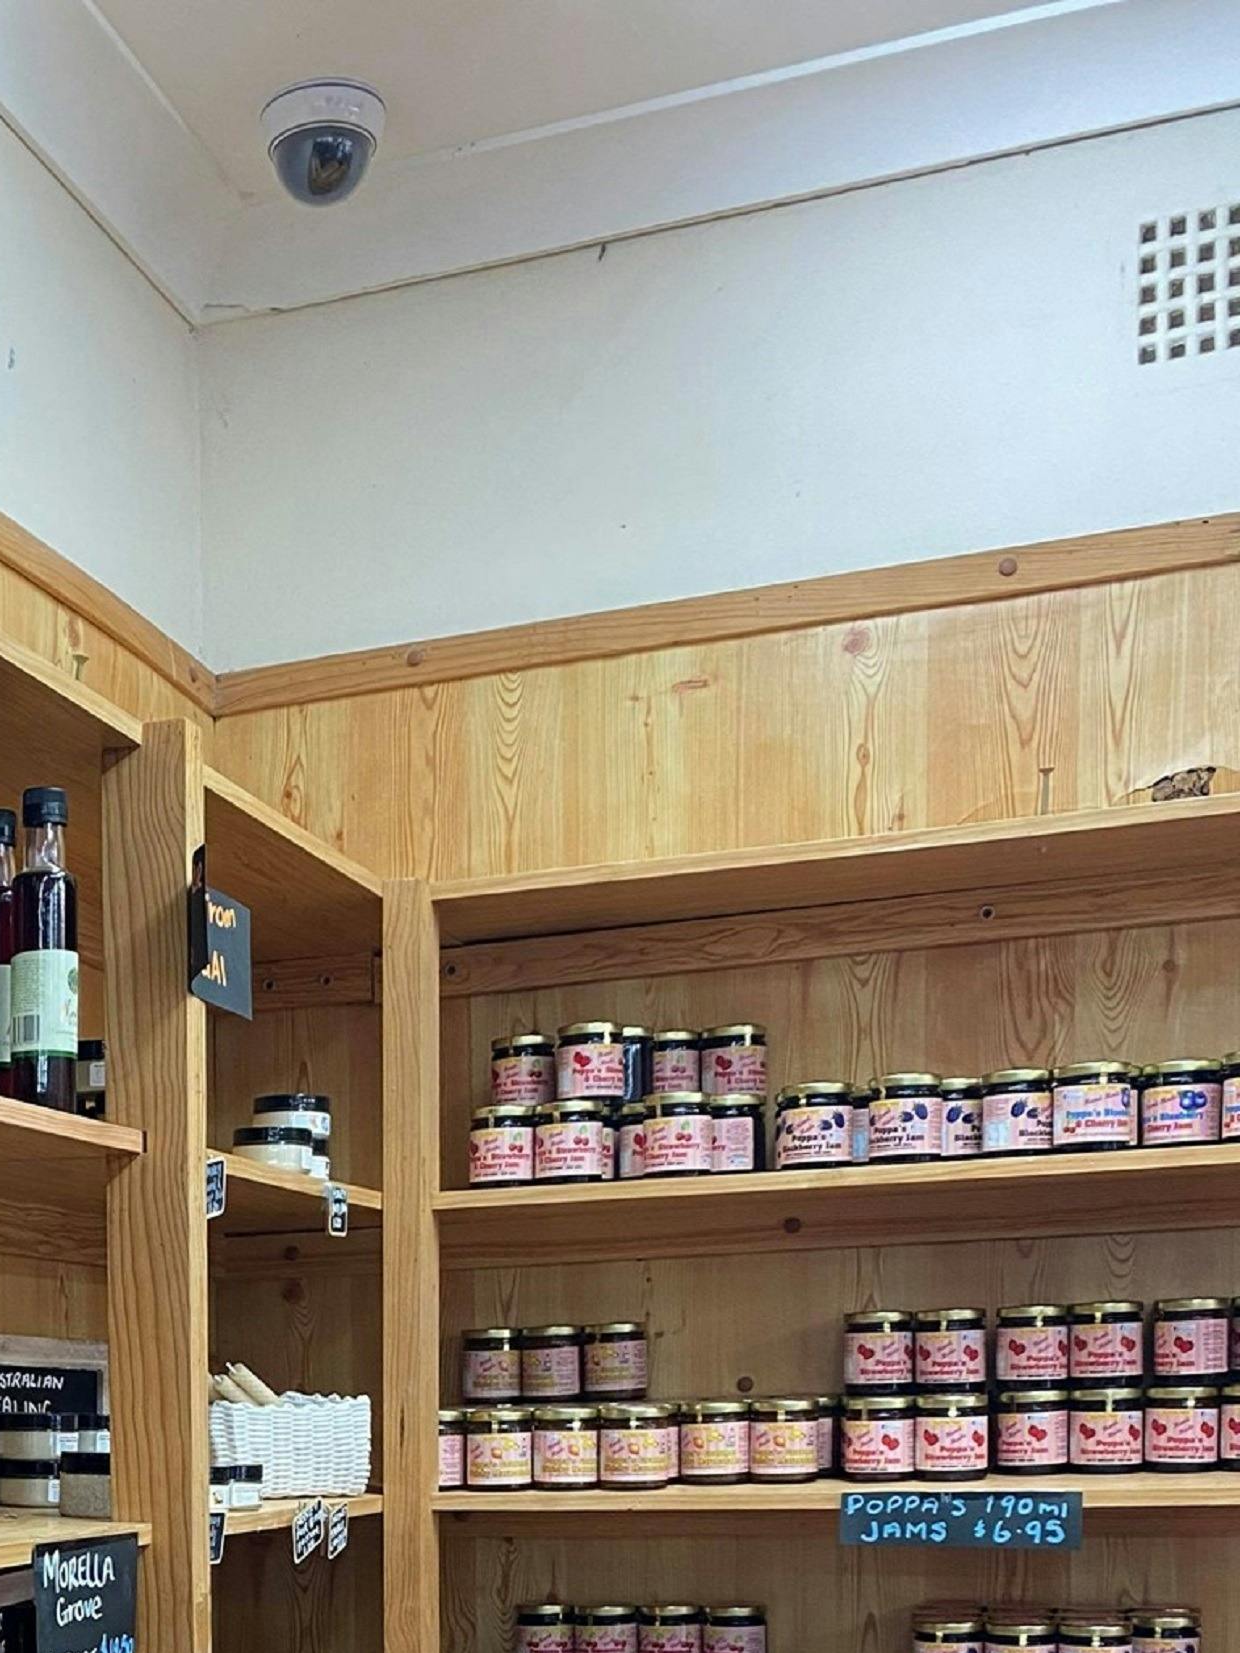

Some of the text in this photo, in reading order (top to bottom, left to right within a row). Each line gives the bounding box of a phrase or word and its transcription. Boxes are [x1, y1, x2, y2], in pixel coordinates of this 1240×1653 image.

[846, 1494, 967, 1517] POPPA'S
[860, 1519, 1065, 1544] JAMS $6.95
[56, 1595, 103, 1627] Grove
